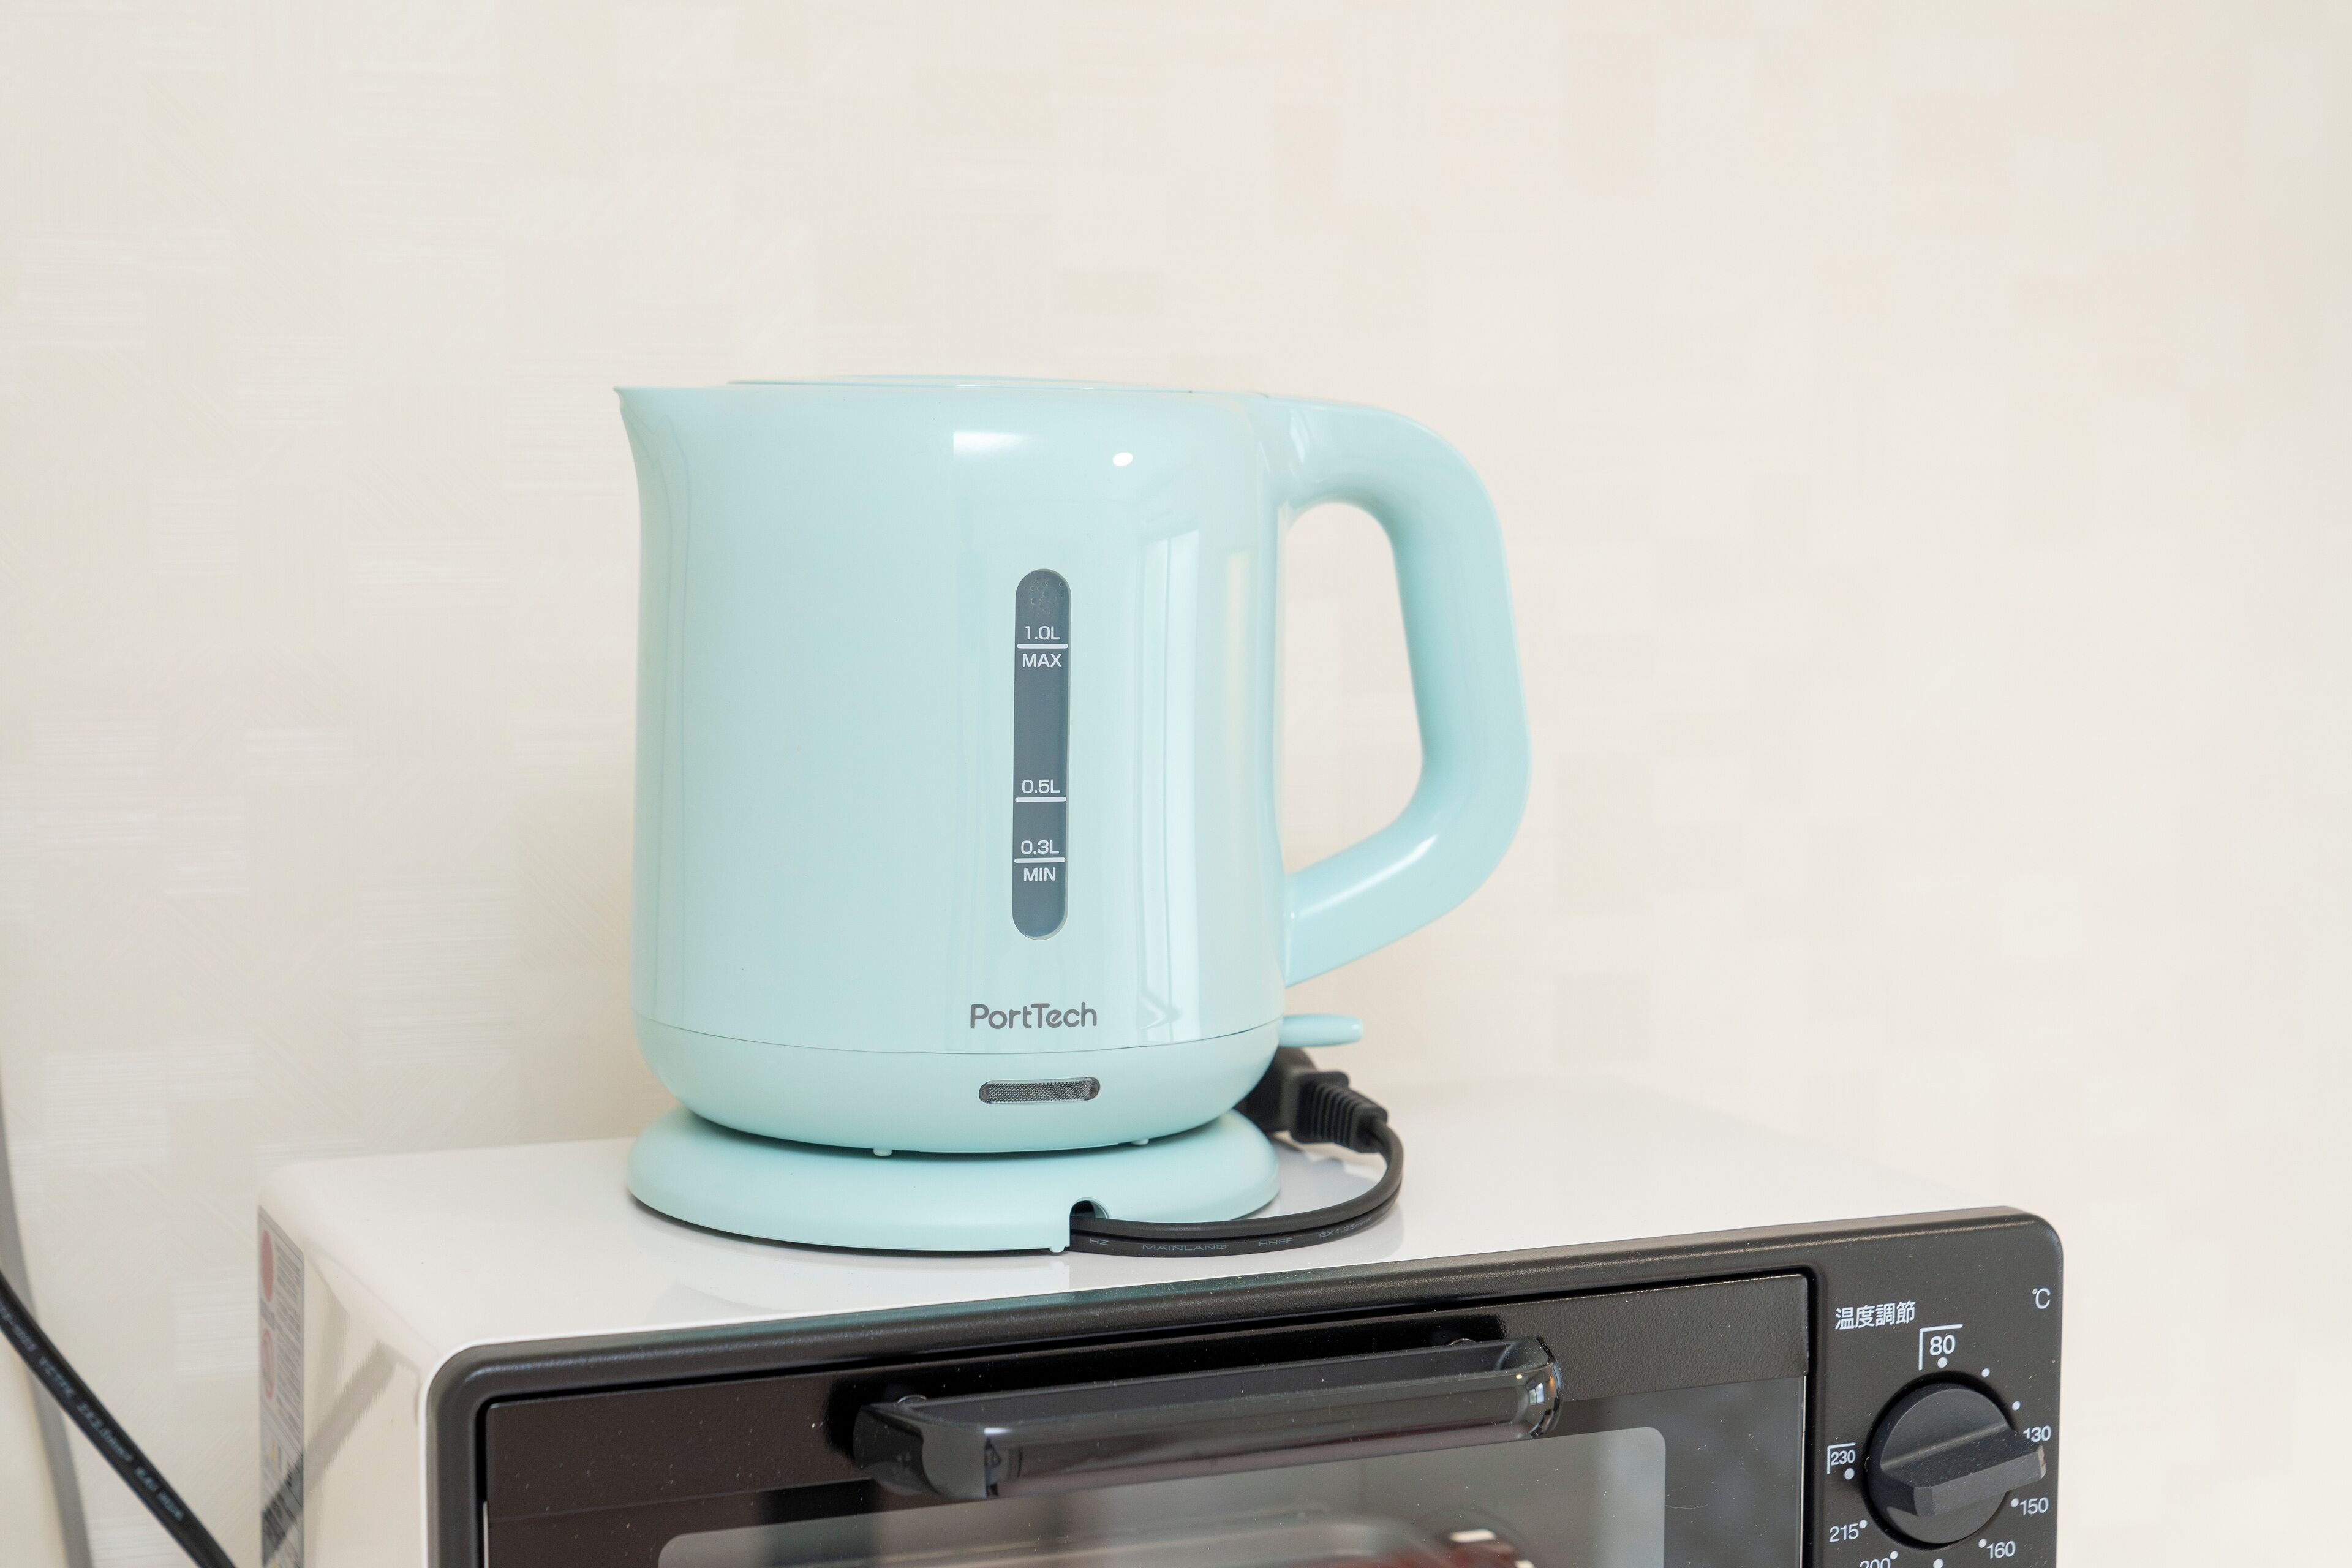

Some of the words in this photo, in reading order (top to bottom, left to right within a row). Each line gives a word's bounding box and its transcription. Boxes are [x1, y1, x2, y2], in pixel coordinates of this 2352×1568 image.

[1025, 625, 1061, 640] 1.0L
[1022, 653, 1062, 668] MAX
[1021, 778, 1060, 794] 0.5L
[1020, 840, 1060, 854] 0.3L
[1023, 867, 1056, 881] MIN
[970, 1001, 1097, 1029] PortTech
[1089, 1237, 1109, 1246] HZ
[1259, 1237, 1294, 1247] HHFF
[1834, 1300, 1917, 1330] 温度調節
[1929, 1334, 1956, 1356] 80
[2022, 1425, 2051, 1442] 130
[1831, 1449, 1856, 1466] 230
[2019, 1496, 2049, 1515] 150
[1829, 1523, 1859, 1542] 215
[1986, 1540, 2016, 1559] 160
